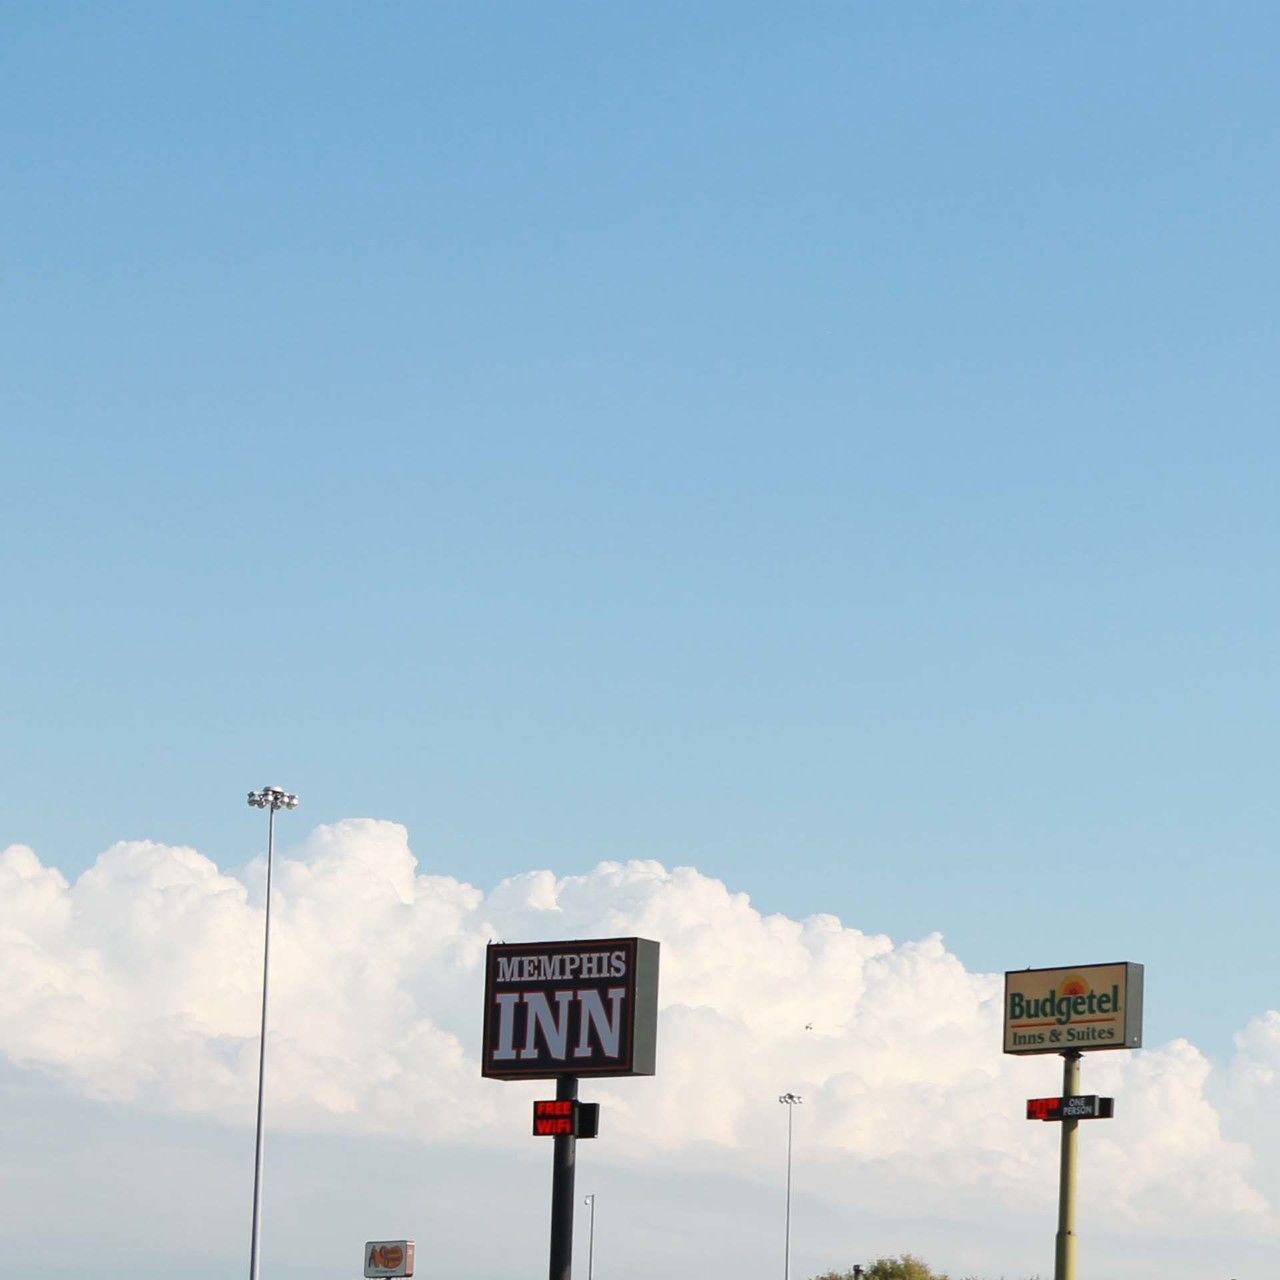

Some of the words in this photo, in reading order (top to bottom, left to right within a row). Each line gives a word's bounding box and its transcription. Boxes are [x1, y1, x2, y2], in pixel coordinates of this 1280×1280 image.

[496, 951, 626, 982] MEMPHIS
[1009, 985, 1120, 1025] Budgetel
[493, 987, 626, 1060] INN
[1012, 1031, 1045, 1046] Inns
[1048, 1029, 1062, 1043] &
[1066, 1026, 1115, 1042] Suites
[537, 1101, 572, 1115] FREE
[1063, 1106, 1093, 1116] PERSON
[1068, 1098, 1086, 1107] ONE
